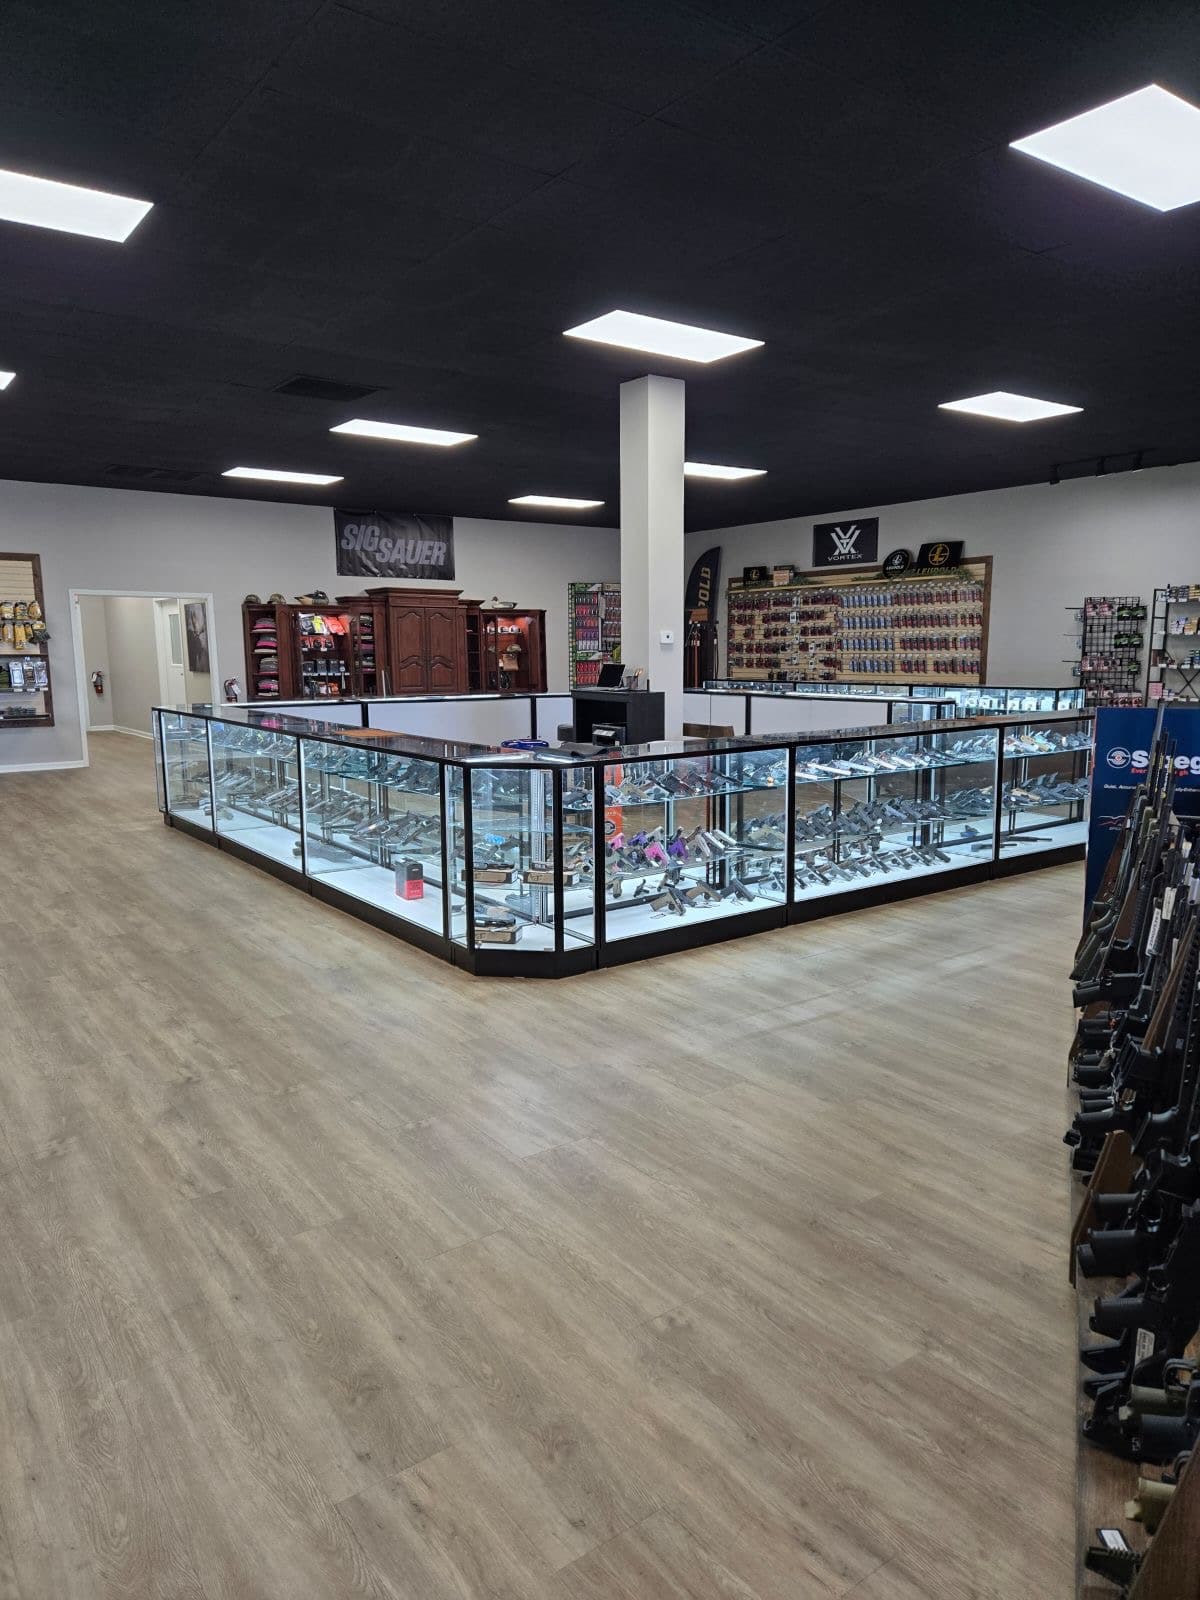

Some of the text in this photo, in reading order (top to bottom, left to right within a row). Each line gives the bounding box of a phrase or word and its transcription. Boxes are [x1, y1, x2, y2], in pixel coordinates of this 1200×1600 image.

[341, 524, 447, 566] SIG SAUER
[828, 553, 864, 561] VORTEX
